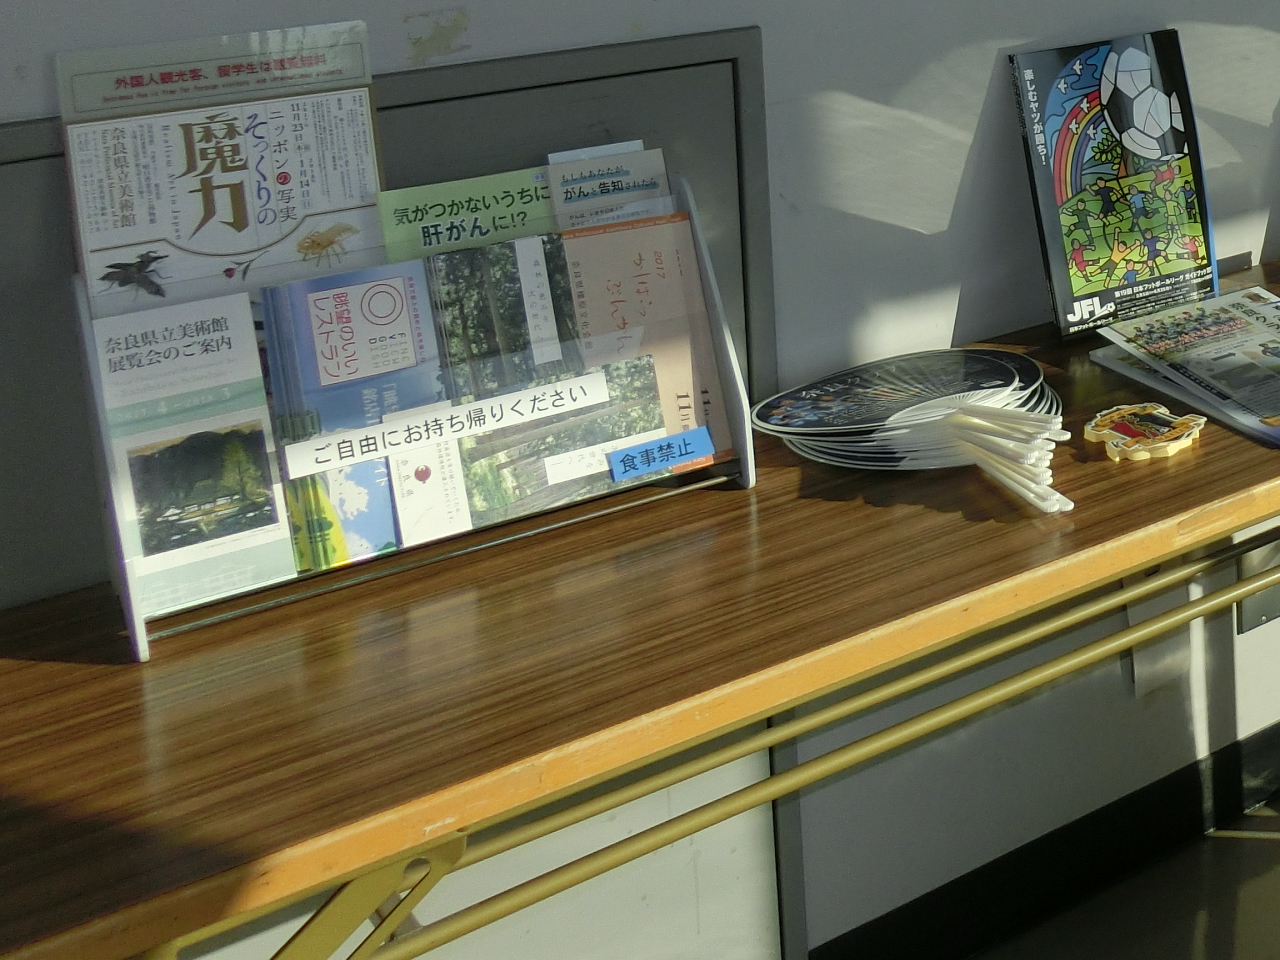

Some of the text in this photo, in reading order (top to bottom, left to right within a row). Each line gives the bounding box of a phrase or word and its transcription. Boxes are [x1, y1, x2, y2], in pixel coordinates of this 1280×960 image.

[112, 127, 138, 228] 奈良県立美術館
[174, 111, 250, 241] 魔力
[243, 113, 277, 227] そっくりの
[269, 110, 298, 222] ニッポンの写実
[563, 178, 658, 201] がんと告知されたら
[393, 185, 550, 227] 気がつかないうちに
[653, 250, 667, 280] 2017
[105, 316, 229, 354] 奈良県立美術館
[313, 296, 341, 379] レストラン
[331, 291, 359, 377] 眺望のいい
[1066, 297, 1108, 322] JFL
[108, 336, 232, 373] 展覧会のご案内
[314, 386, 588, 465] ご自由にお持ち帰りください
[619, 437, 695, 474] 食事禁止
